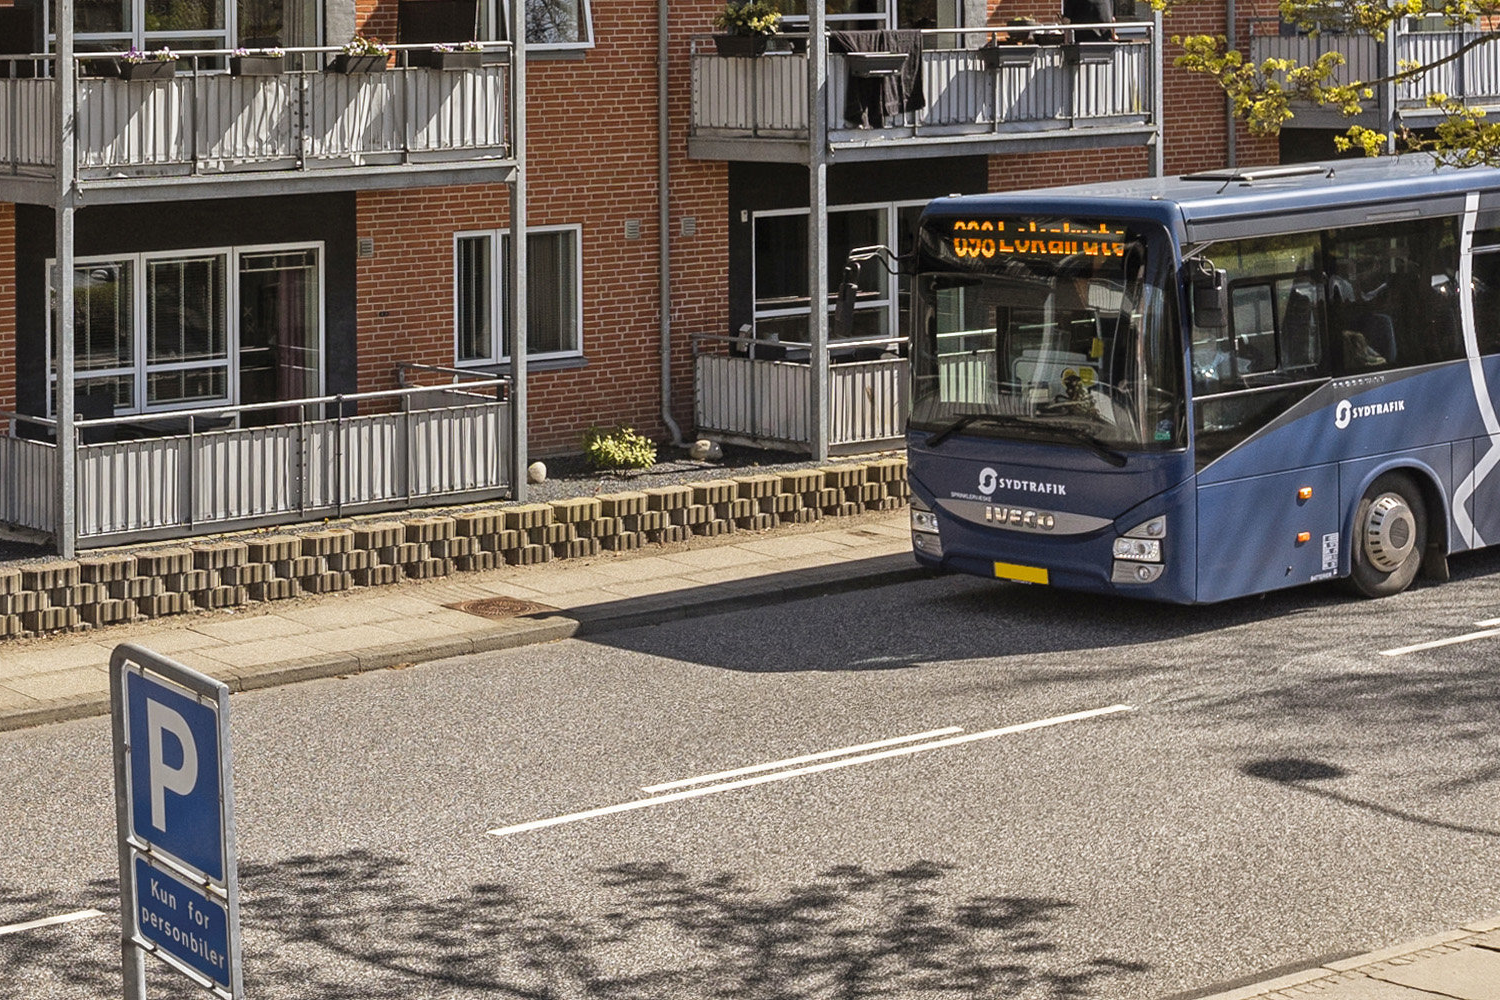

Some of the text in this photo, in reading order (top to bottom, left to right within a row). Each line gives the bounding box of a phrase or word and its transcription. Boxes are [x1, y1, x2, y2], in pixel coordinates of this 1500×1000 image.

[1352, 400, 1405, 419] SYDTRAFIK
[999, 478, 1067, 496] SYDTRAFIK
[985, 506, 1055, 530] IVECO
[146, 697, 199, 833] P
[150, 878, 210, 930] Kun for
[141, 906, 225, 969] personbiler
